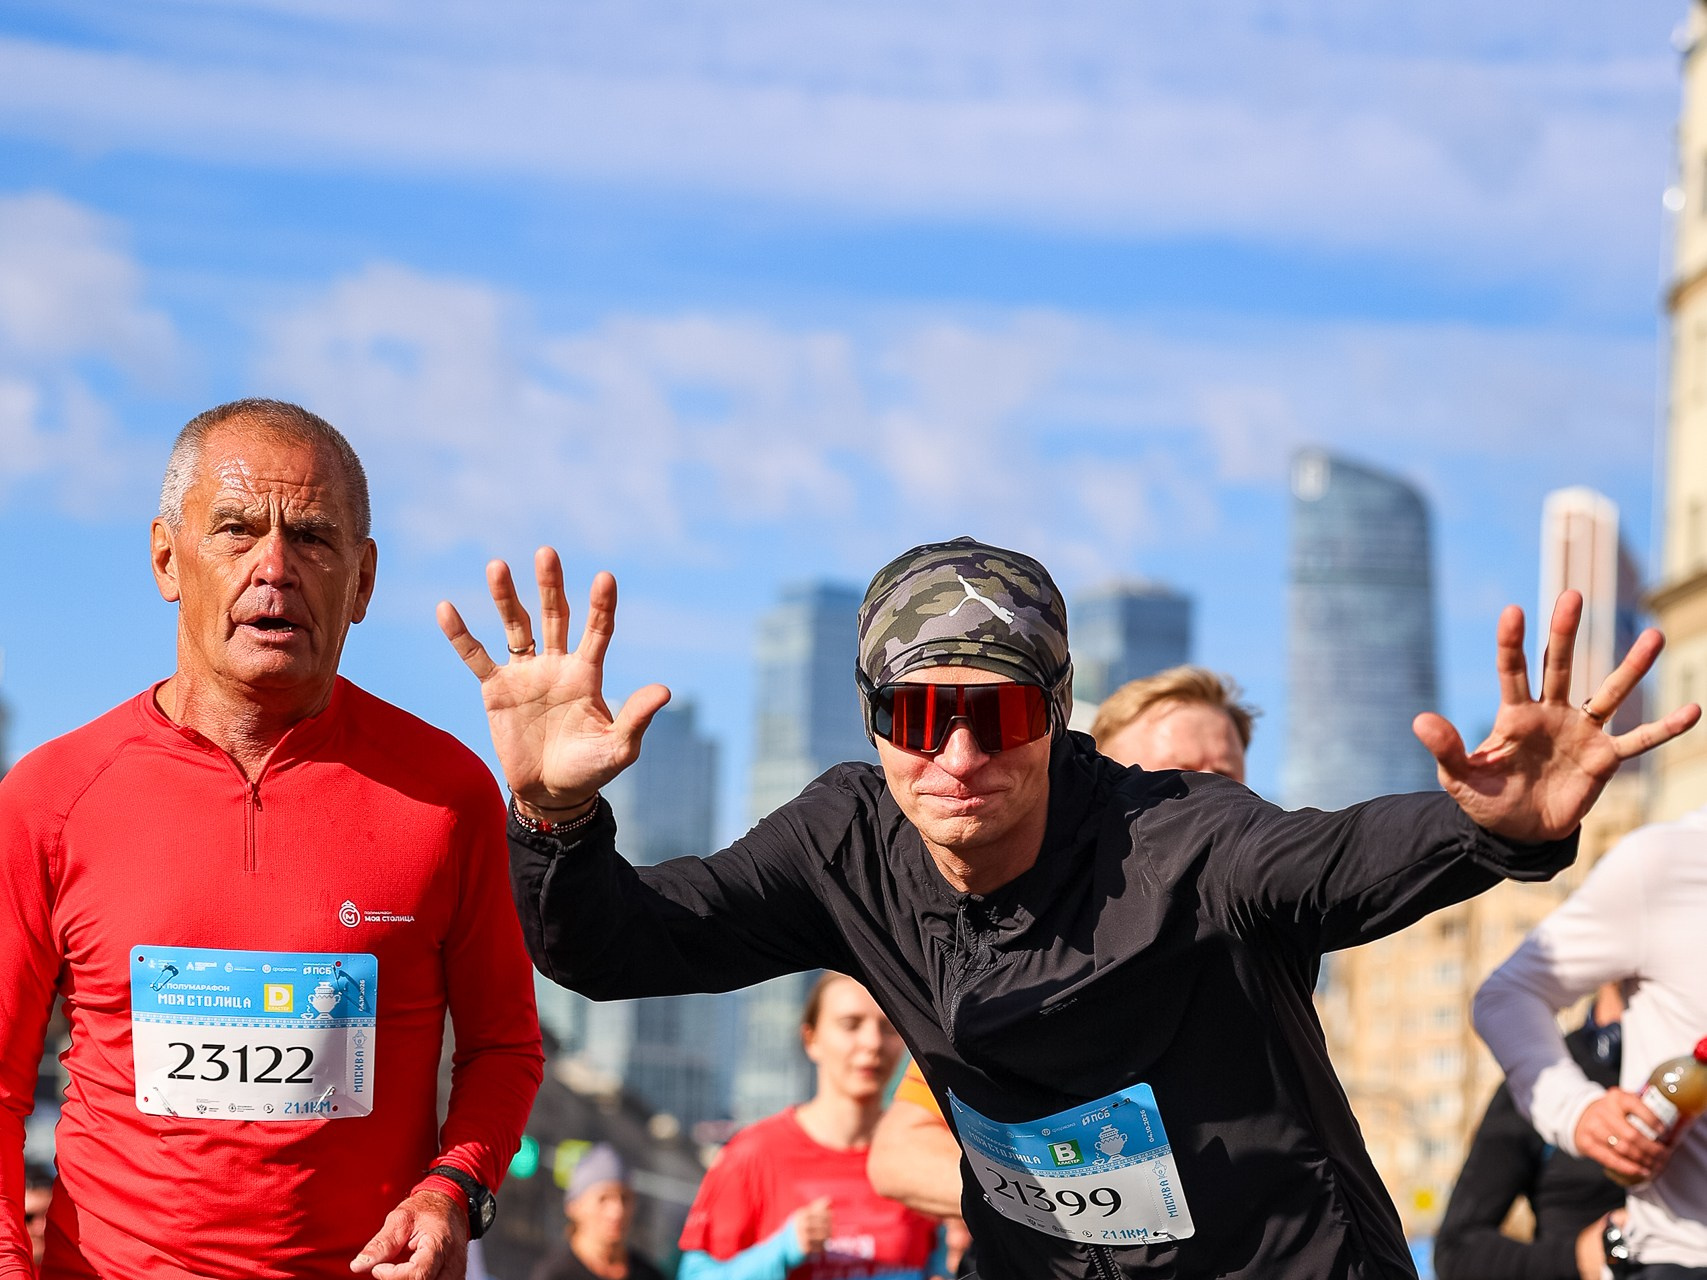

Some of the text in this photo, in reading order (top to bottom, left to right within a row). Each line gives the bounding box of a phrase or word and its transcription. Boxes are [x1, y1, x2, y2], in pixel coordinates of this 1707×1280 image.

[381, 915, 415, 923] СТОЛИЦА
[312, 966, 332, 975] ПСБ
[167, 983, 230, 992] ПОЛУМАРАФОН
[268, 986, 291, 1007] D
[157, 993, 251, 1009] МОЯ СТОЛИЦА
[167, 1042, 315, 1084] 23122
[354, 1050, 364, 1093] МОСКВА
[1091, 1108, 1111, 1123] ПСБ
[1053, 1143, 1076, 1162] B
[985, 1166, 1123, 1218] 21399
[1159, 1179, 1179, 1218] МОСКВА
